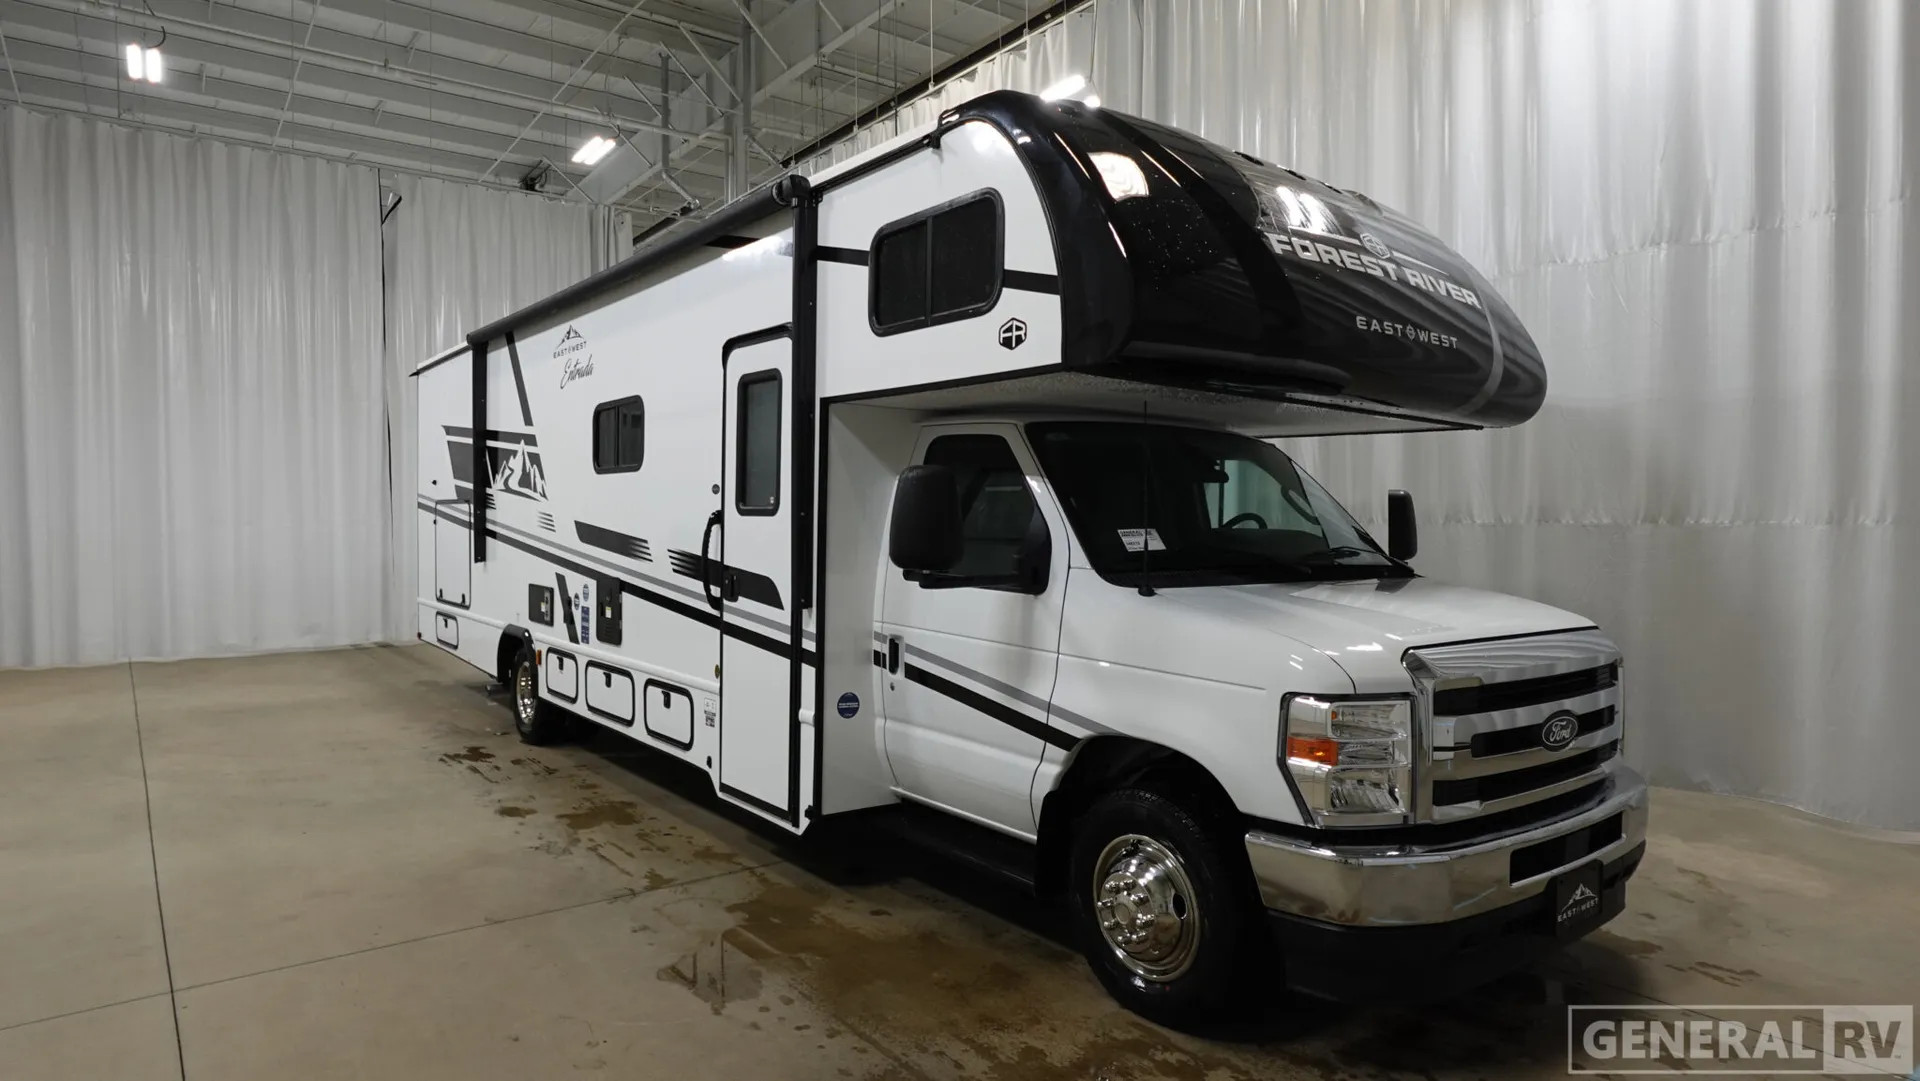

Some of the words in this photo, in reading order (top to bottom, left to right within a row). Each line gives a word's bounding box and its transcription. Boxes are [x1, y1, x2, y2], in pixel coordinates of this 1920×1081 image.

[1263, 231, 1398, 281] FOREST
[1402, 266, 1483, 310] RIVER
[1355, 315, 1403, 337] EAST
[1418, 330, 1458, 350] WEST
[560, 353, 594, 389] Entrada
[1549, 720, 1573, 742] Ford
[1557, 907, 1577, 923] EAST
[1580, 897, 1599, 912] WEST
